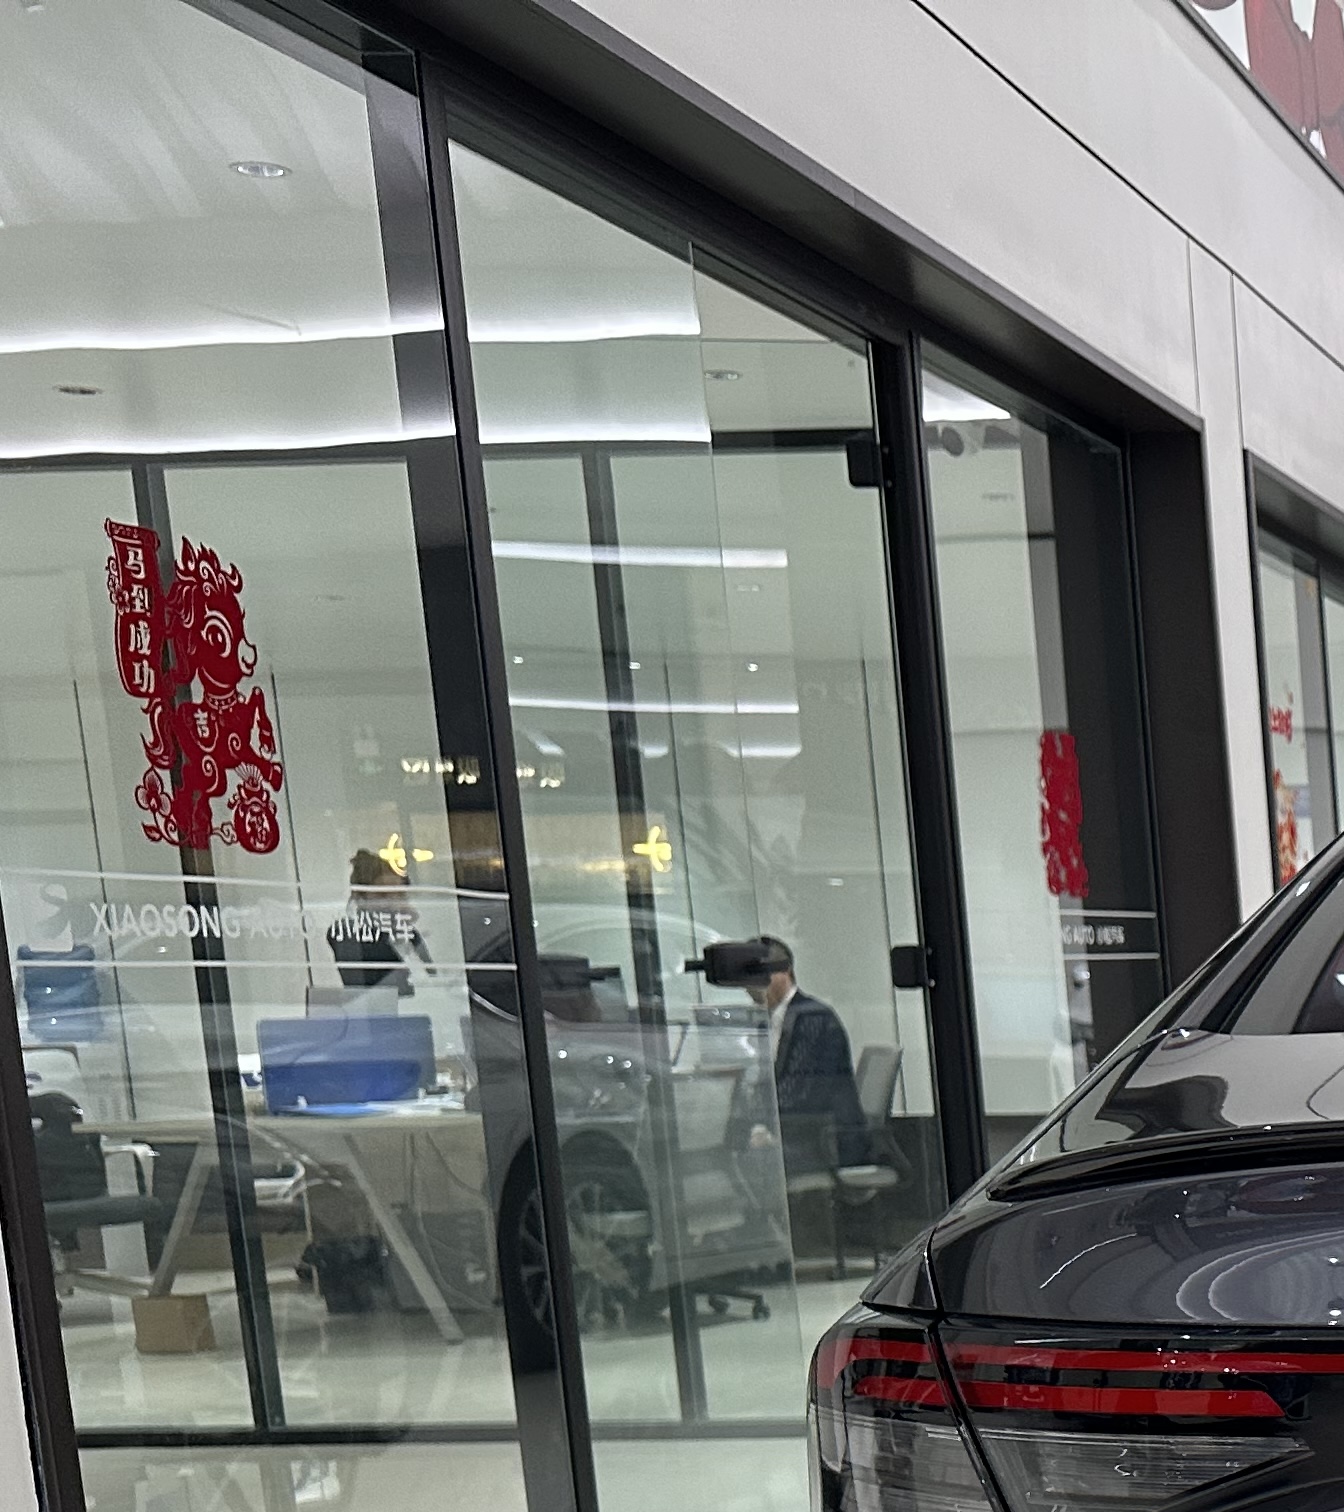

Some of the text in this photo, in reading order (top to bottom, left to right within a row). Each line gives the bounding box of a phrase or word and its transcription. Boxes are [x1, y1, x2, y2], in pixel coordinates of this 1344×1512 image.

[124, 546, 155, 693] 马到成功
[89, 902, 241, 938] XIAOSONG
[330, 911, 415, 942] 小松汽车
